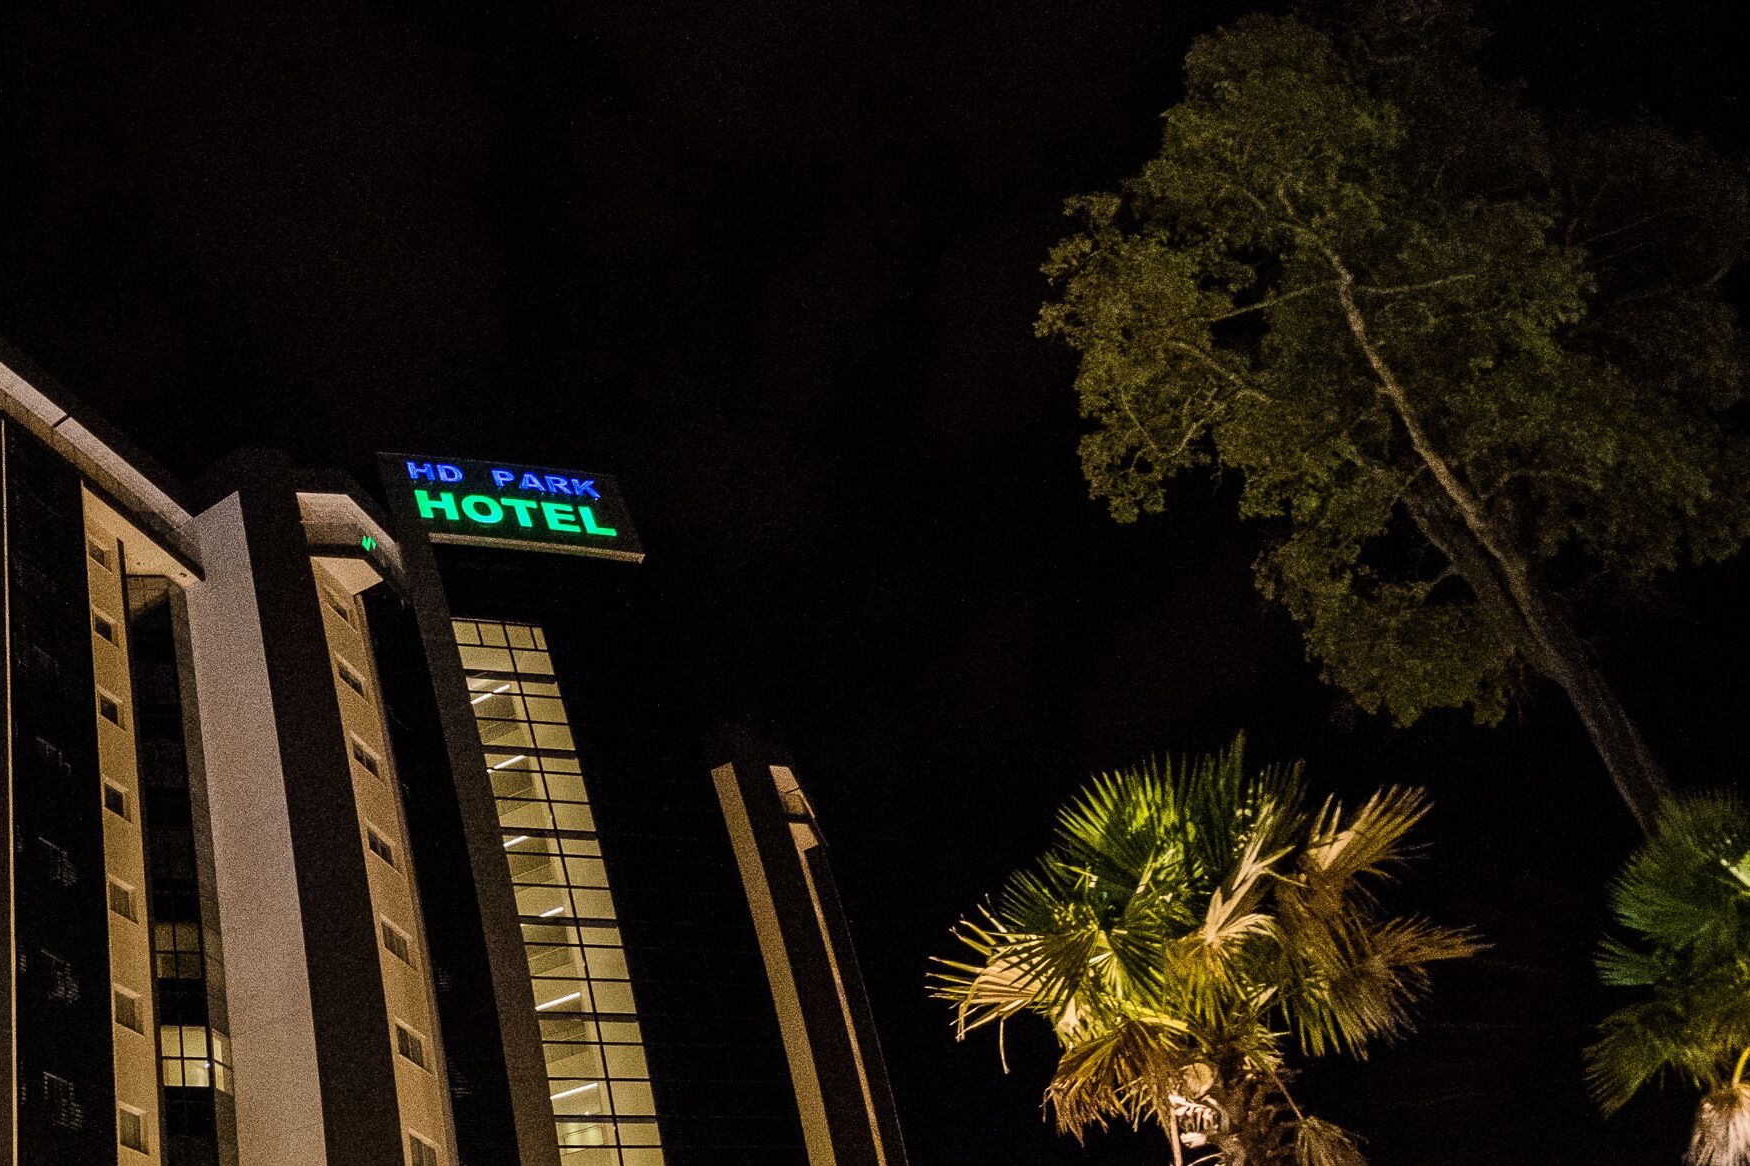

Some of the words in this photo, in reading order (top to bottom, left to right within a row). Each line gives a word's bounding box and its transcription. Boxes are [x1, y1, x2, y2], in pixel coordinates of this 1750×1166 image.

[405, 461, 465, 484] HD
[490, 468, 601, 499] PARK
[414, 489, 618, 537] HOTEL
